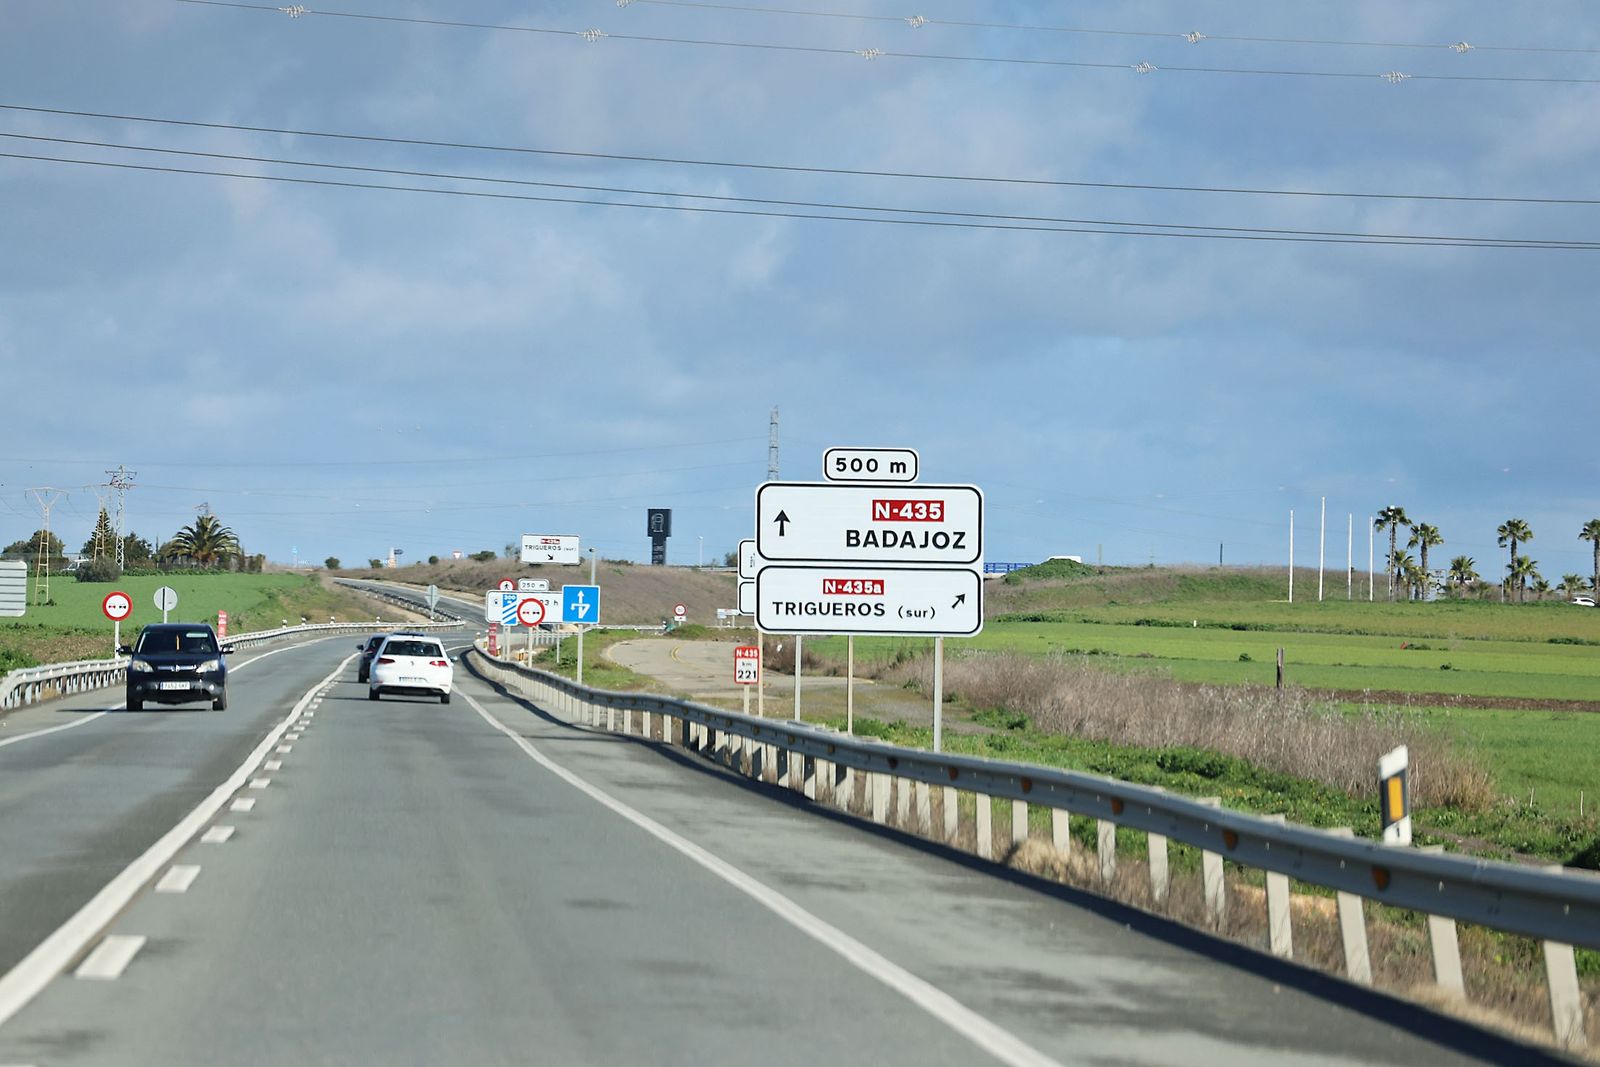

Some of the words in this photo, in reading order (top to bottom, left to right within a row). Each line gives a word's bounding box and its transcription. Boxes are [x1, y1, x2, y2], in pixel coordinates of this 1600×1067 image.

[836, 458, 879, 473] 500
[890, 460, 907, 474] m
[875, 502, 942, 520] N-435
[846, 529, 966, 550] BADAJOZ
[824, 580, 882, 594] N-435a
[772, 601, 885, 617] TRIGUEROS
[898, 606, 936, 620] (sur)
[736, 649, 758, 657] N-435
[738, 670, 756, 679] 221
